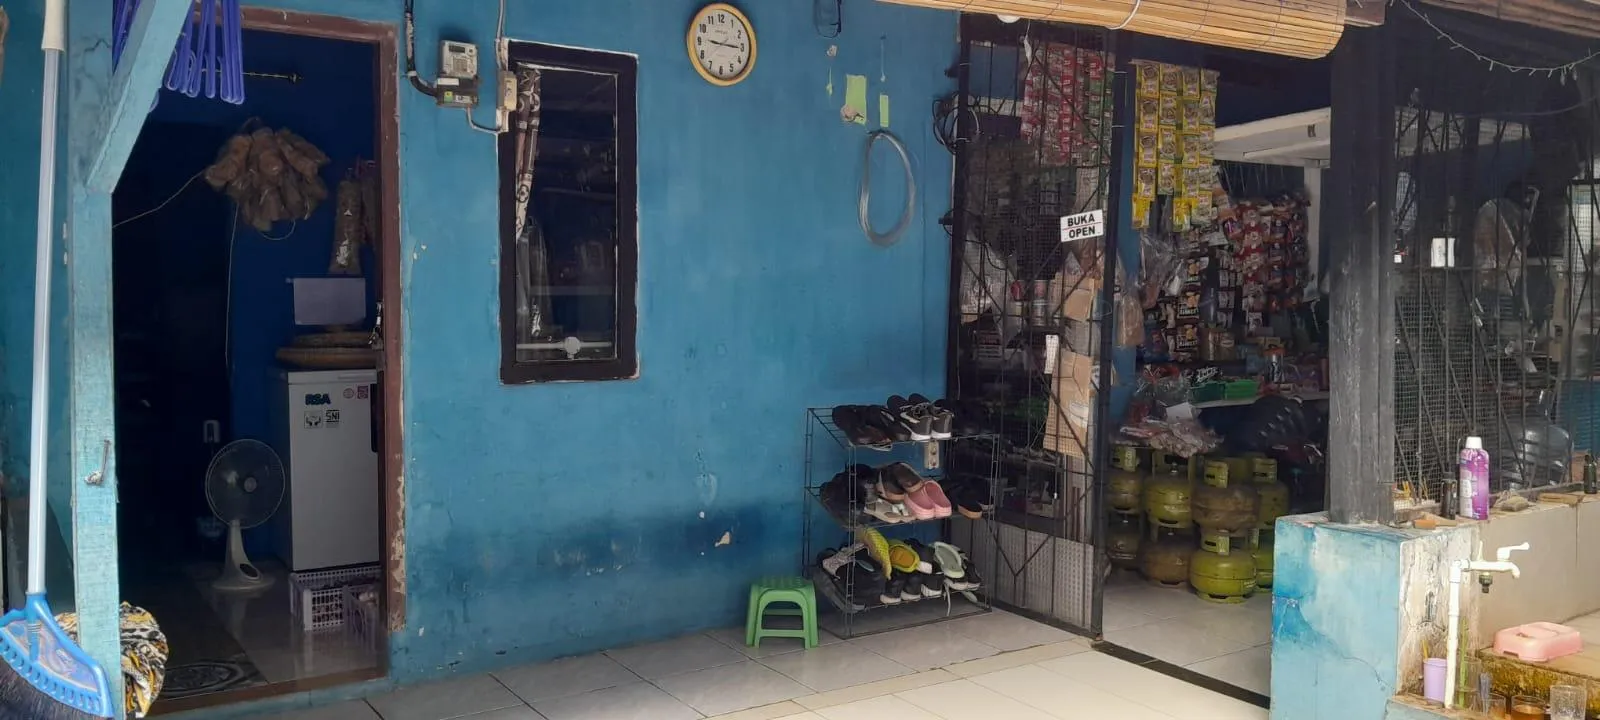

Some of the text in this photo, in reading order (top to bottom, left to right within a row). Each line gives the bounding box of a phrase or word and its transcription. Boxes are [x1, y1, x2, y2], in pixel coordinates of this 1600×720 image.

[1067, 213, 1096, 227] BUKA
[1068, 226, 1096, 239] OPEN
[305, 393, 331, 406] RSA
[325, 411, 340, 421] SNI
